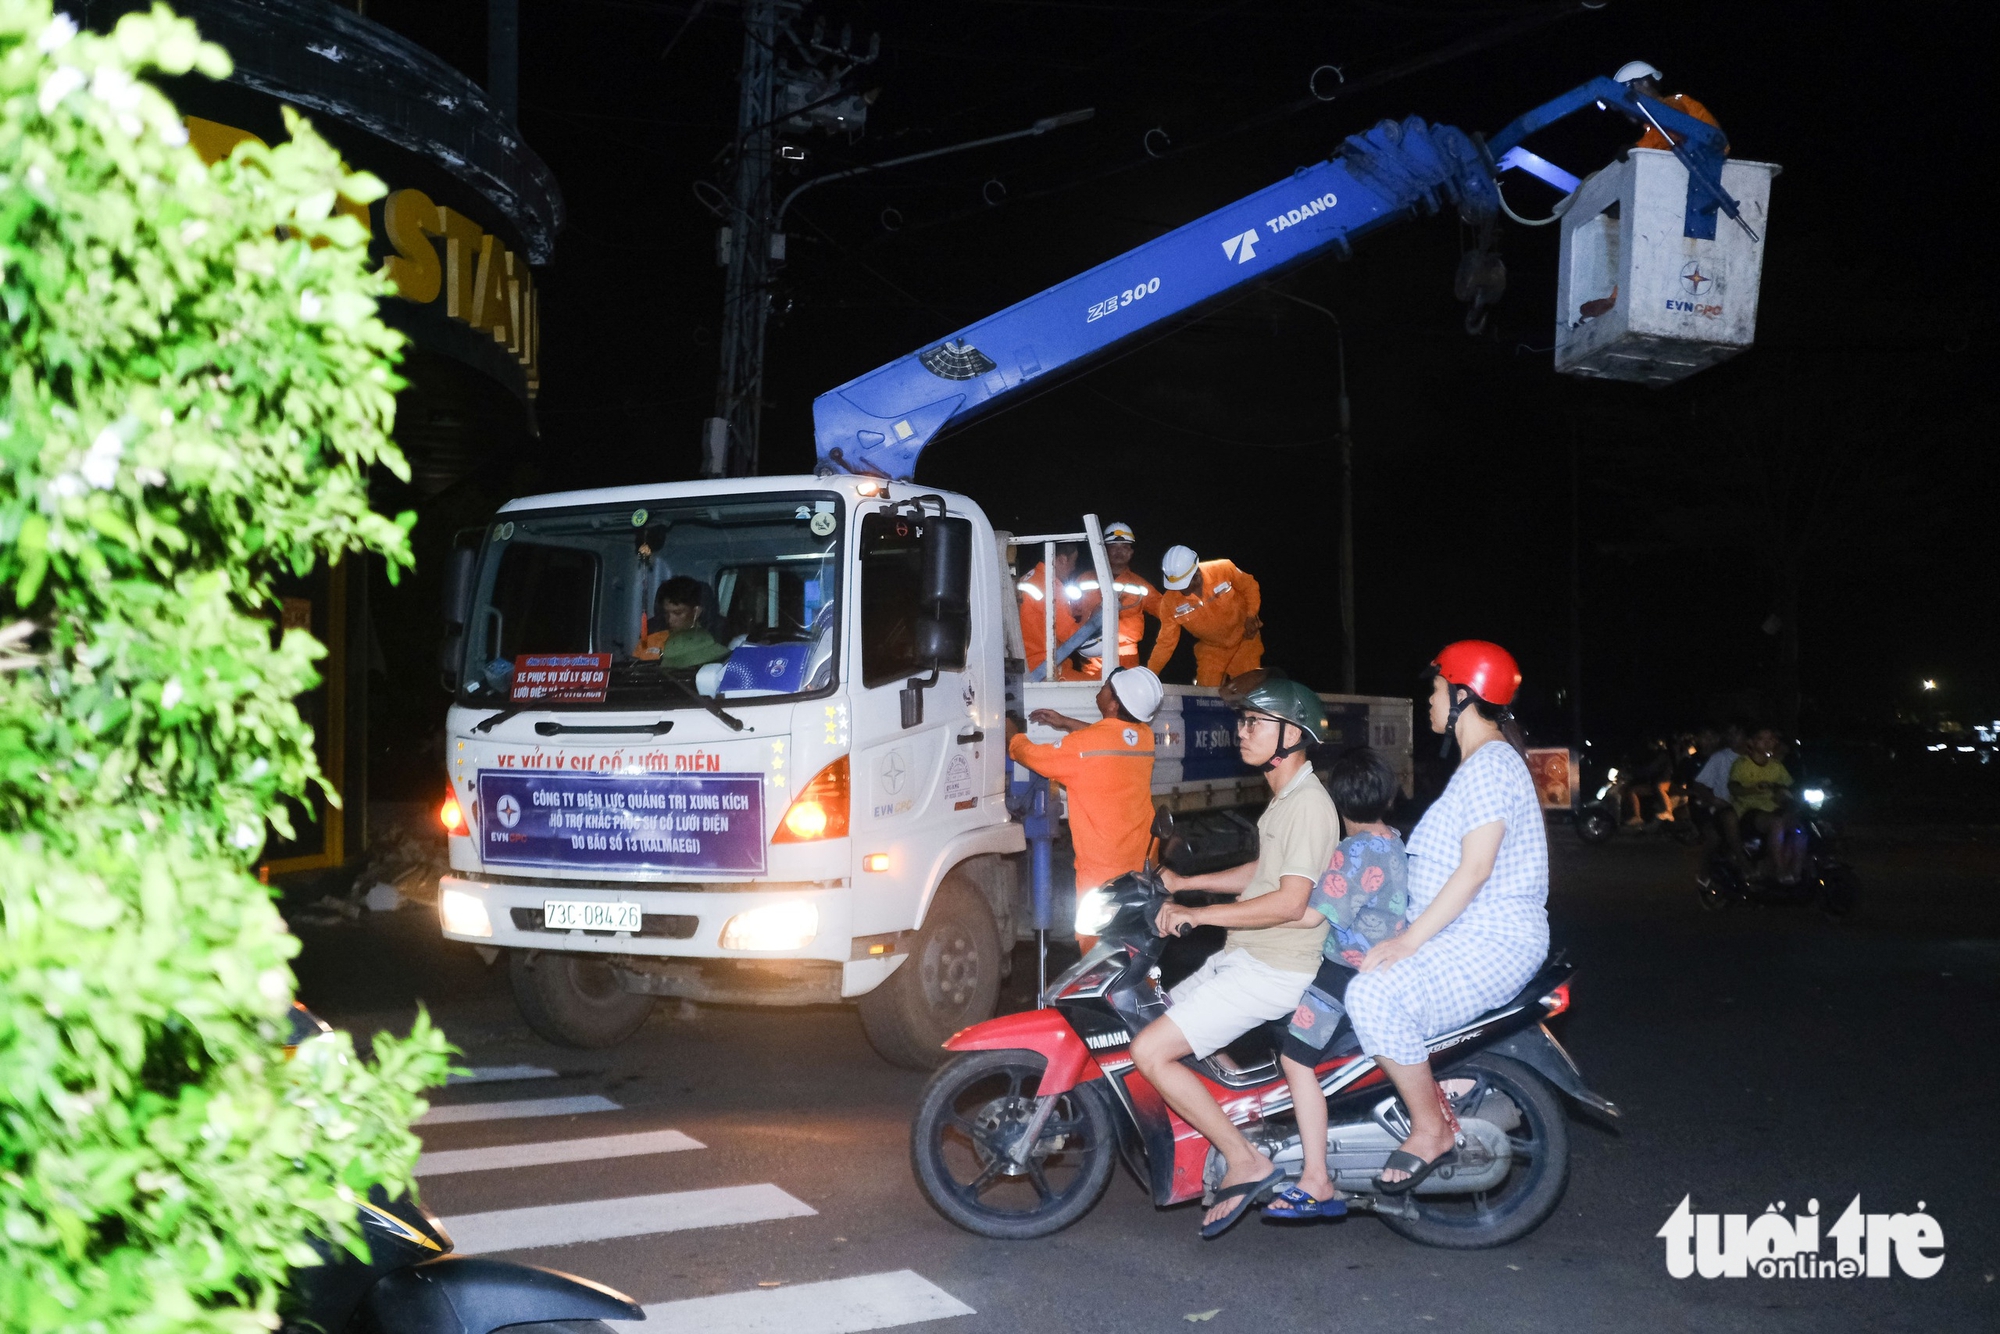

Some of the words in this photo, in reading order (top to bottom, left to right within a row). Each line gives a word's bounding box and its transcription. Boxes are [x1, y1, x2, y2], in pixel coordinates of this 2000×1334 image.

[1266, 193, 1338, 234] TADANO
[517, 672, 526, 682] XE
[527, 671, 546, 684] PHỤC
[548, 671, 557, 685] VỤ
[581, 671, 592, 685] SỰ
[1195, 730, 1208, 748] XE
[1211, 724, 1231, 748] SỬA
[533, 789, 560, 807] CÔNG
[562, 792, 574, 807] TY
[576, 790, 603, 811] ĐIỆN
[604, 792, 625, 813] LỰC
[628, 790, 666, 810] QUẢNG
[668, 795, 687, 812] TRỊ
[689, 795, 720, 810] XUNG
[722, 792, 749, 810] KÍCH
[565, 813, 584, 831] TRỢ
[585, 810, 611, 829] KHẮC
[659, 811, 674, 831] CỐ
[676, 814, 700, 831] LƯỚI
[702, 813, 729, 835] ĐIỆN
[572, 835, 585, 849] DO
[587, 833, 607, 850] BÃO
[609, 832, 623, 851] SỐ
[625, 838, 638, 851] 13
[640, 838, 701, 854] (KALMAEGI)
[1086, 1031, 1130, 1049] YAMAHA
